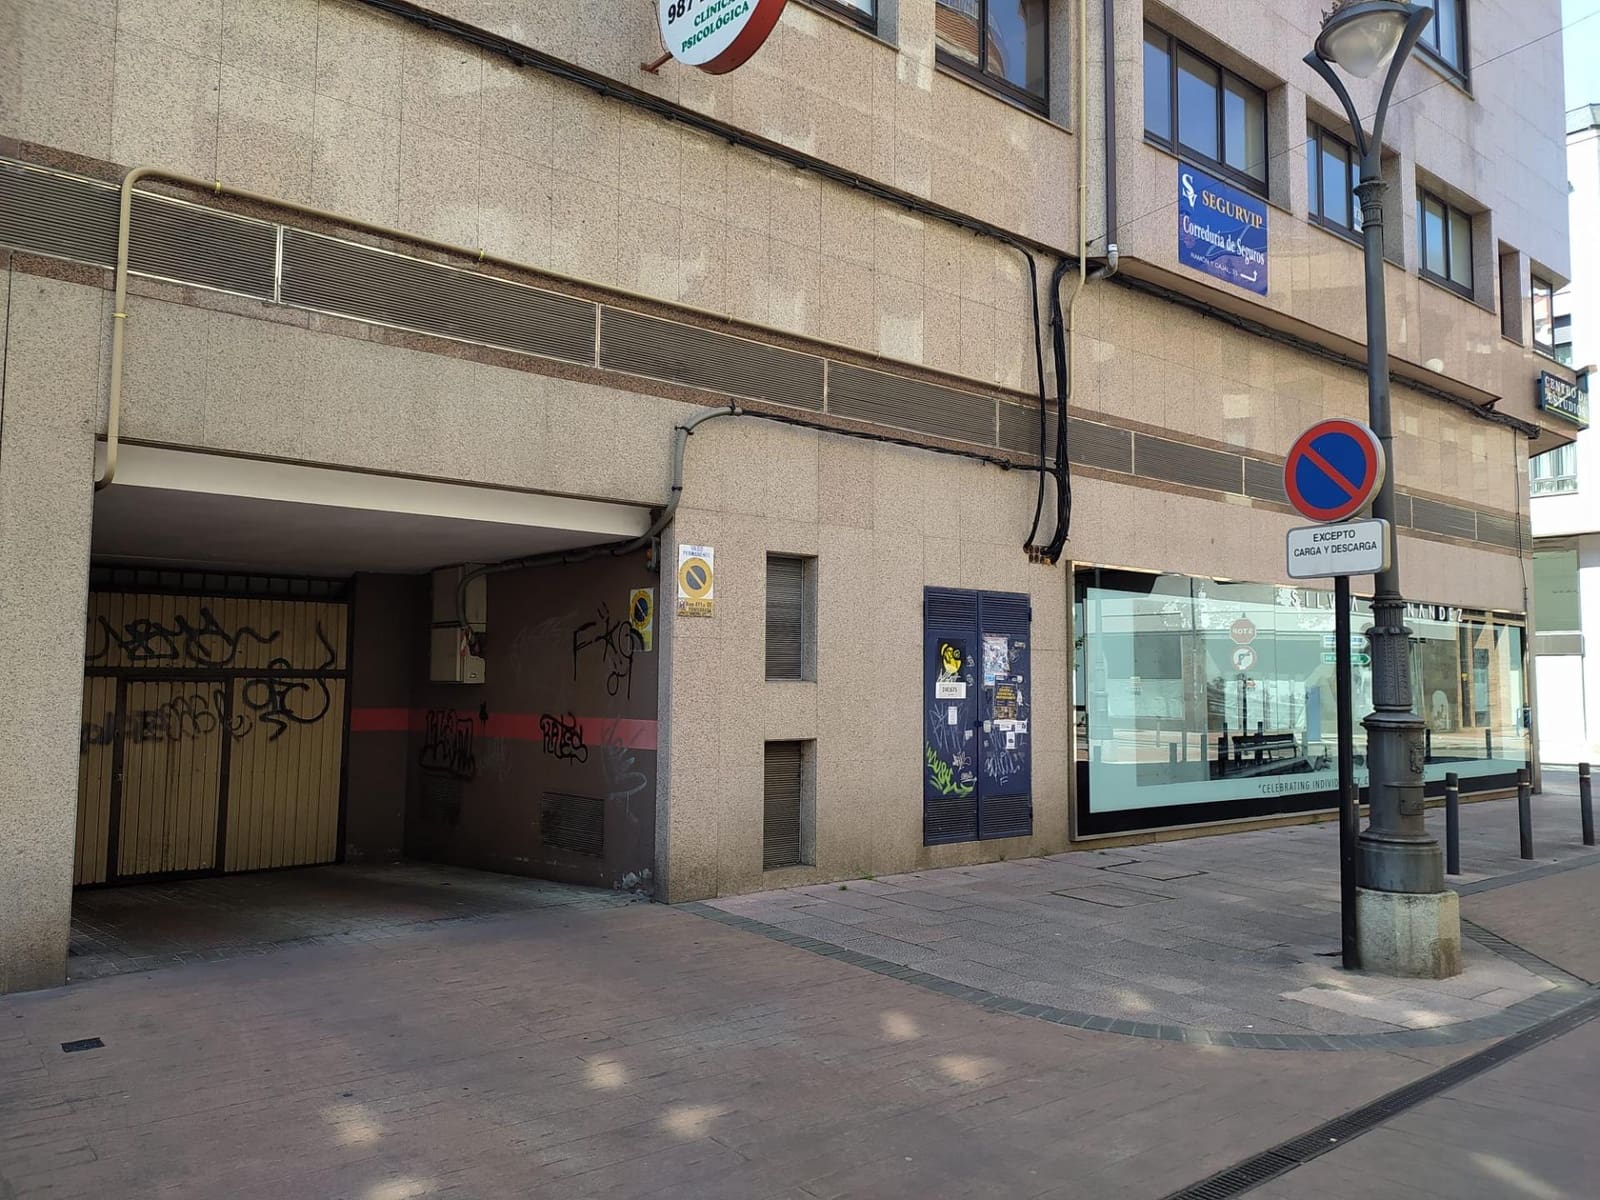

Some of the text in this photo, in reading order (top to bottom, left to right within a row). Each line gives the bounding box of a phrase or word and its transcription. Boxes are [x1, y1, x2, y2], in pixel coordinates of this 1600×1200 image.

[681, 1, 750, 53] PSICOLÓGICA
[1202, 190, 1263, 230] SEGURVIP
[1183, 215, 1265, 266] Correduría de Seguros
[1545, 376, 1577, 399] CENTRO
[1313, 529, 1356, 542] EXCEPTO
[1294, 541, 1377, 557] CARGA Y DESCARGA
[1290, 590, 1359, 612] SILVA
